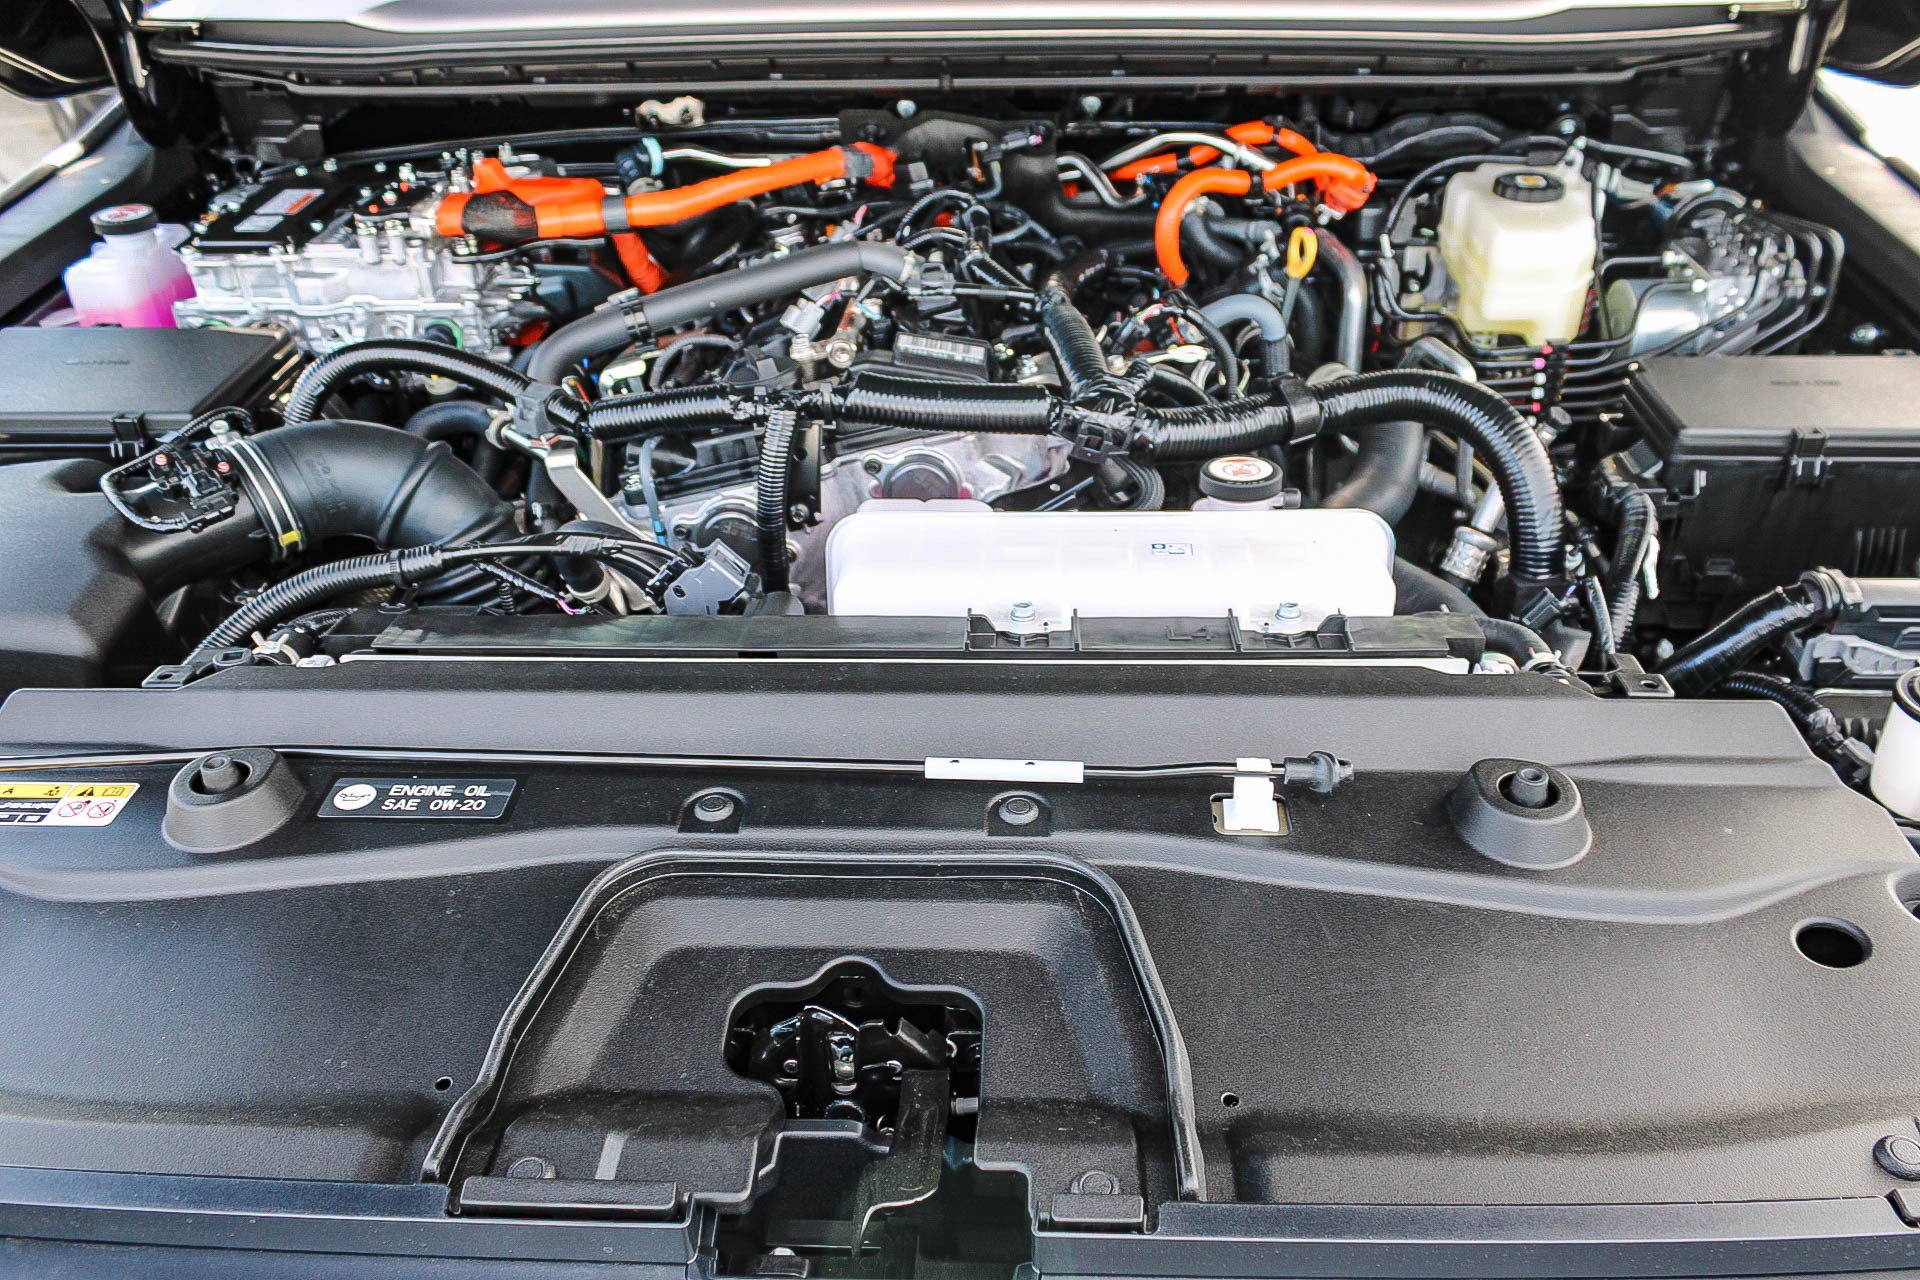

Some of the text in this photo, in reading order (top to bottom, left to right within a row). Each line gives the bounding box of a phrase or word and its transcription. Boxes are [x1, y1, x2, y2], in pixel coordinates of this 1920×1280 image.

[388, 784, 492, 797] ENGINE OIL
[381, 798, 487, 811] SAE 0W-20
